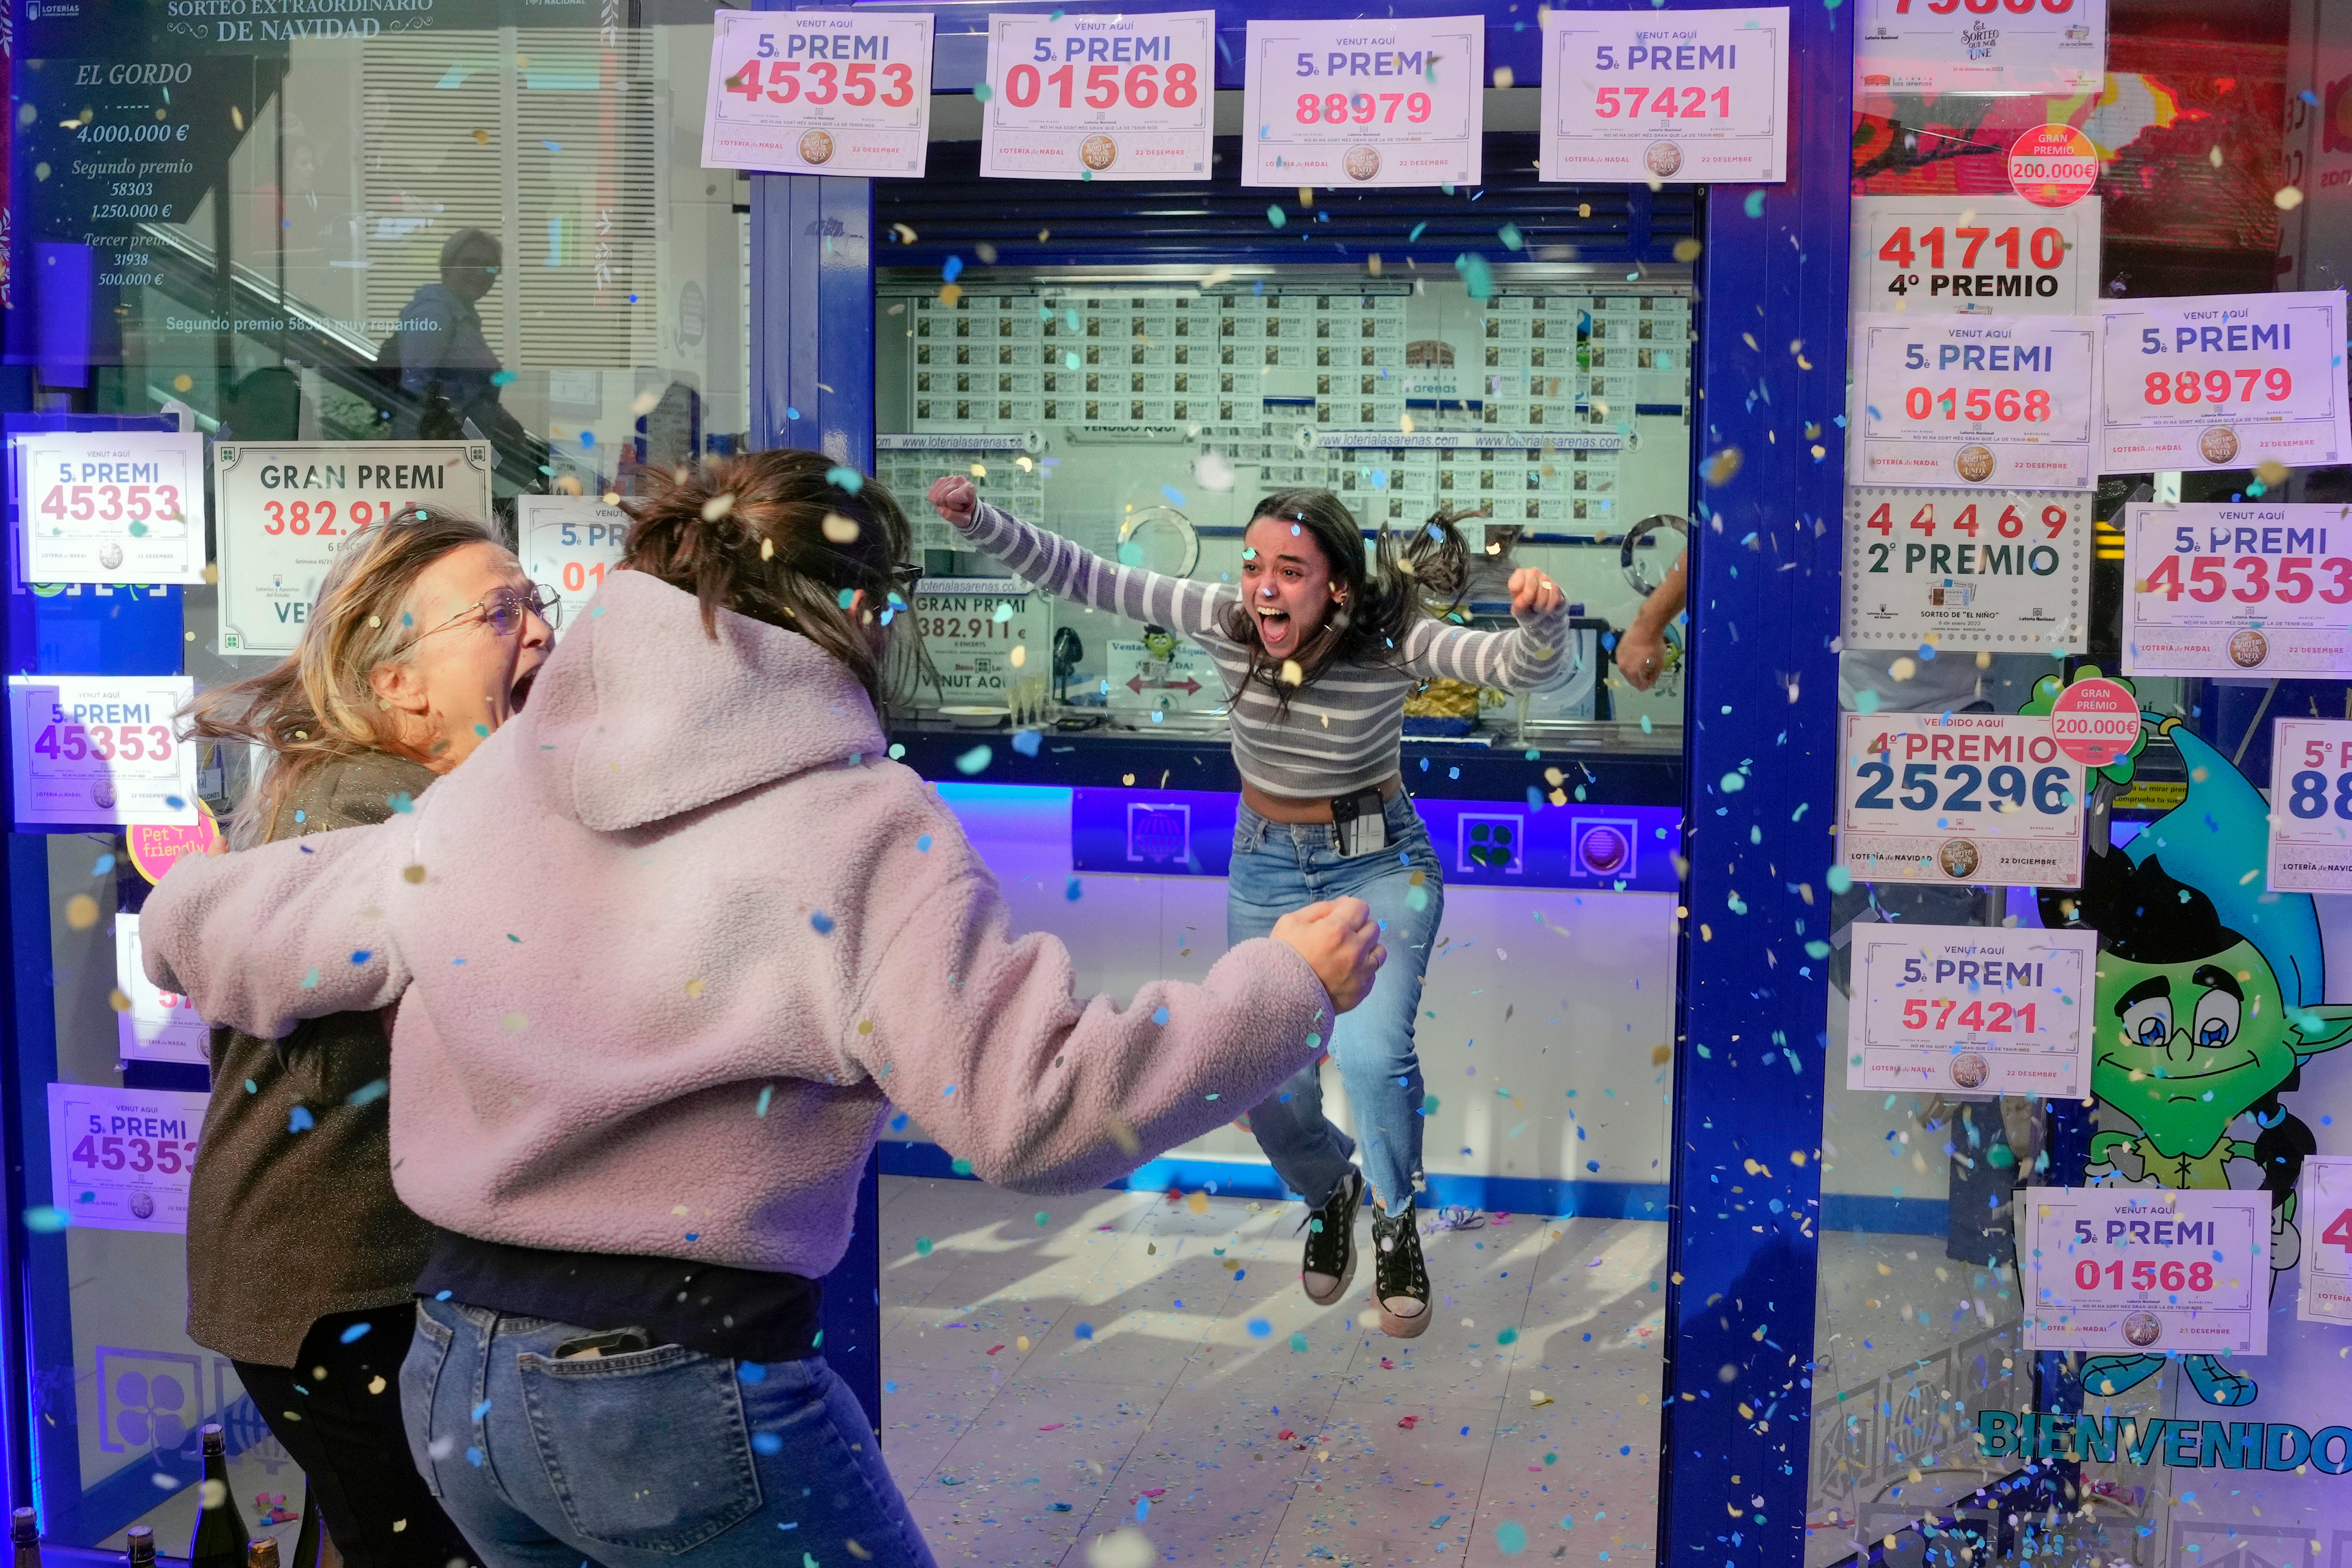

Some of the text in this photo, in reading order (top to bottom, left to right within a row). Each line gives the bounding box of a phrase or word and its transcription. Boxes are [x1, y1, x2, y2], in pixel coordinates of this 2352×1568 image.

[169, 0, 433, 16] SORTEO EXTRAORDINARIO
[217, 18, 380, 42] DE NAVIDAD
[830, 20, 854, 28] AQUÍ
[1110, 22, 1134, 30] AQUÍ
[1672, 30, 1697, 38] AQUÍ
[788, 35, 889, 60] PREMI
[1371, 37, 1395, 45] AQUÍ
[1961, 30, 1999, 44] SORTEO
[1066, 36, 1170, 62] PREMI
[1628, 45, 1735, 70] PREMI
[1967, 48, 1991, 60] UNE
[75, 63, 192, 85] EL GORDO
[727, 60, 913, 107] 45353
[1006, 63, 1197, 109] 01568
[1296, 93, 1431, 124] 88979
[1595, 87, 1729, 118] 57421
[76, 125, 189, 143] 4.000.000 €
[2039, 134, 2068, 143] GRAN
[2034, 146, 2074, 155] PREMIO
[71, 158, 193, 179] Segundo premio
[2013, 163, 2096, 178] 200.000€
[110, 182, 153, 196] 58303
[92, 204, 172, 218] 1.250.000 €
[84, 233, 128, 246] Tercer
[1879, 226, 2065, 269] 41710
[113, 254, 149, 266] 31938
[98, 273, 164, 286] 500.000 €
[1888, 274, 2058, 297] 4º PREMIO
[2183, 308, 2248, 320] VENUT AQUÍ
[166, 317, 230, 333] Segundo
[234, 318, 284, 334] premio
[371, 318, 442, 331] repartido.
[1949, 329, 2011, 338] VENUT AQUÍ
[2176, 324, 2290, 353] PREMI
[1939, 345, 2051, 372] PREMI
[2145, 368, 2292, 405] 88979
[1906, 387, 2050, 422] 01568
[82, 463, 158, 483] PREMI
[260, 465, 444, 489] GRAN PREMI
[41, 485, 180, 520] 45353
[2258, 511, 2284, 520] AQUÍ
[2210, 527, 2326, 553] PREMI
[1868, 542, 2059, 576] 2º PREMIO
[2142, 555, 2352, 604] 45353
[916, 597, 966, 611] GRAN
[2081, 689, 2110, 697] GRAN
[74, 704, 150, 723] PREMI
[2077, 701, 2117, 710] PREMIO
[1976, 718, 2004, 727] AQUÍ
[2056, 719, 2137, 735] 200.000€
[35, 726, 172, 760] 45353
[1906, 734, 2057, 763] PREMIO
[2303, 740, 2333, 768] 5º
[1855, 762, 2071, 814] 25296
[142, 828, 169, 842] Pet
[1944, 946, 2004, 955] VENUT AQUÍ
[1936, 960, 2042, 986] PREMI
[1902, 999, 2036, 1033] 57421
[112, 1116, 186, 1139] PREMI
[2107, 1221, 2213, 1244] PREMI
[2075, 1260, 2213, 1292] 01568
